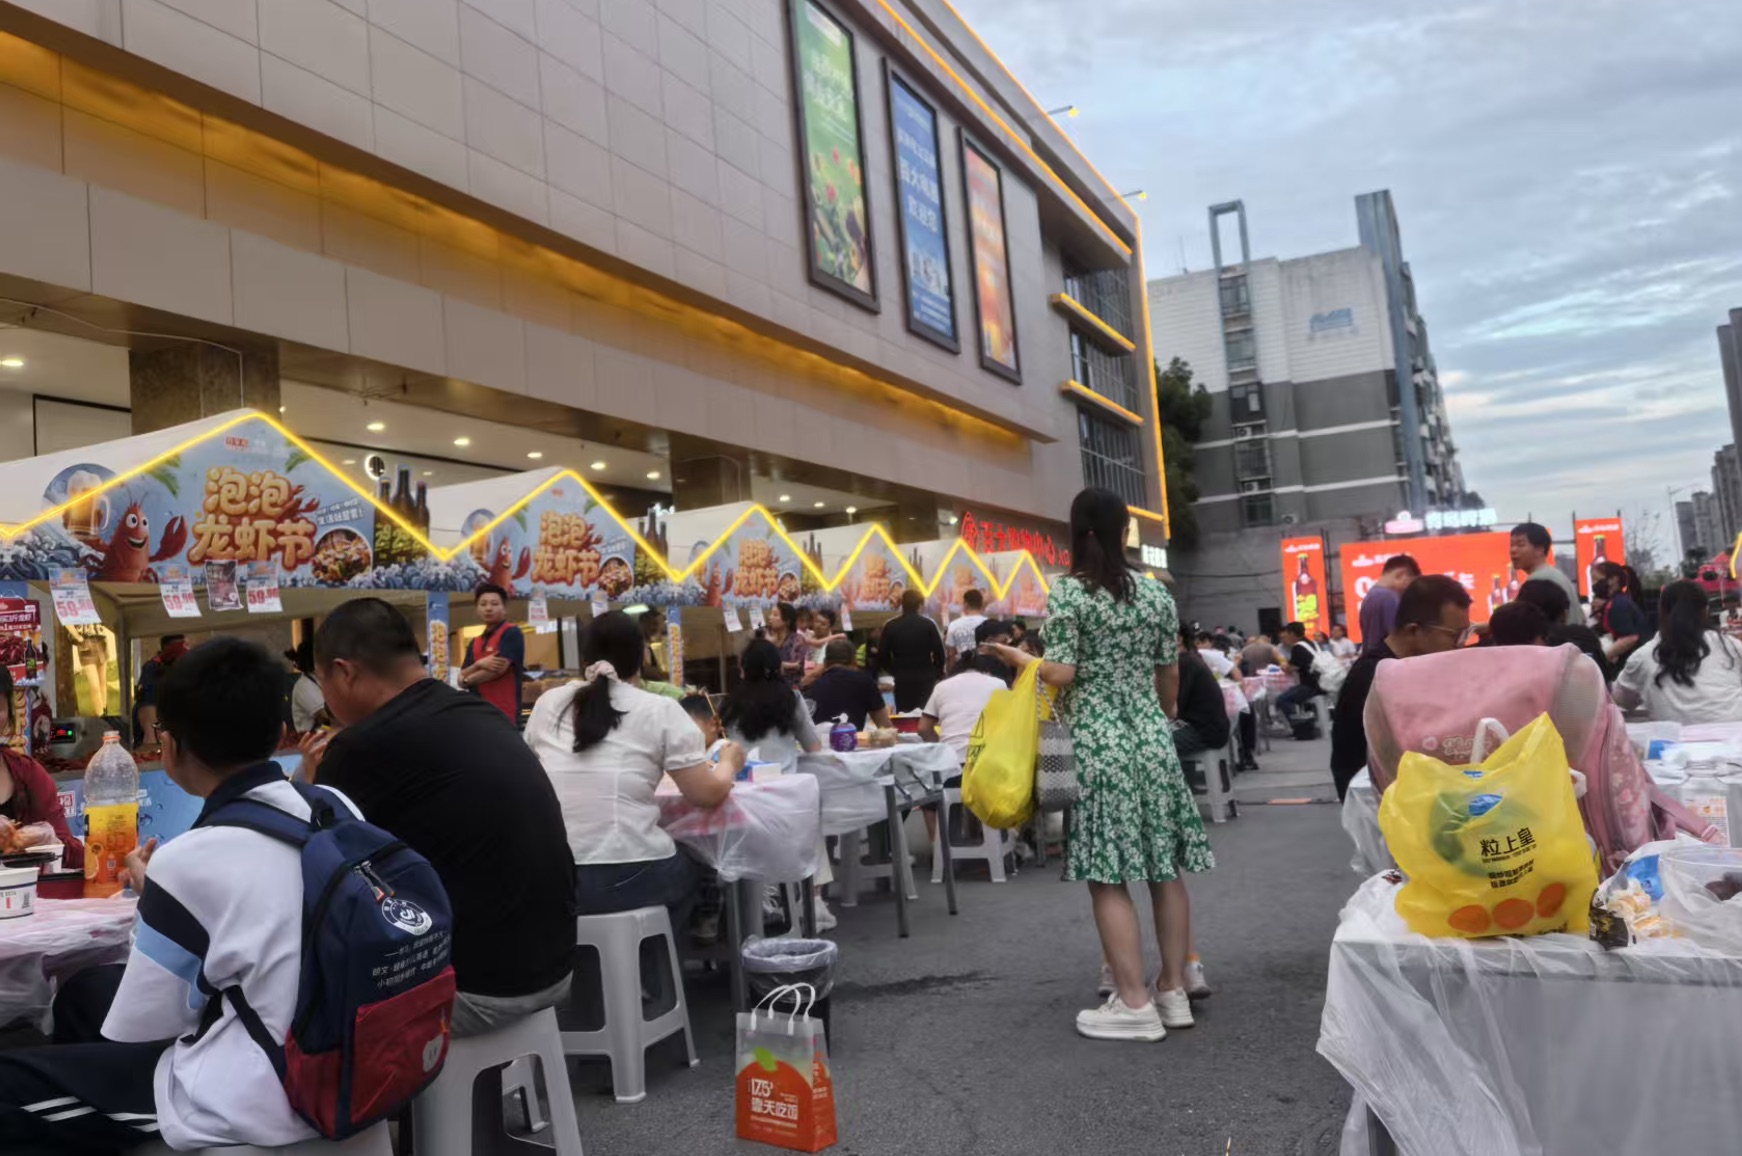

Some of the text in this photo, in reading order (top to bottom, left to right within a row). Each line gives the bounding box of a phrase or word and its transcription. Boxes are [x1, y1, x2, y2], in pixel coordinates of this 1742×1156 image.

[204, 467, 291, 518] 泡泡
[188, 514, 316, 570] 龙虾节
[539, 510, 587, 547] 泡泡
[531, 545, 600, 588] 龙虾节
[1479, 827, 1536, 857] 粒上皇
